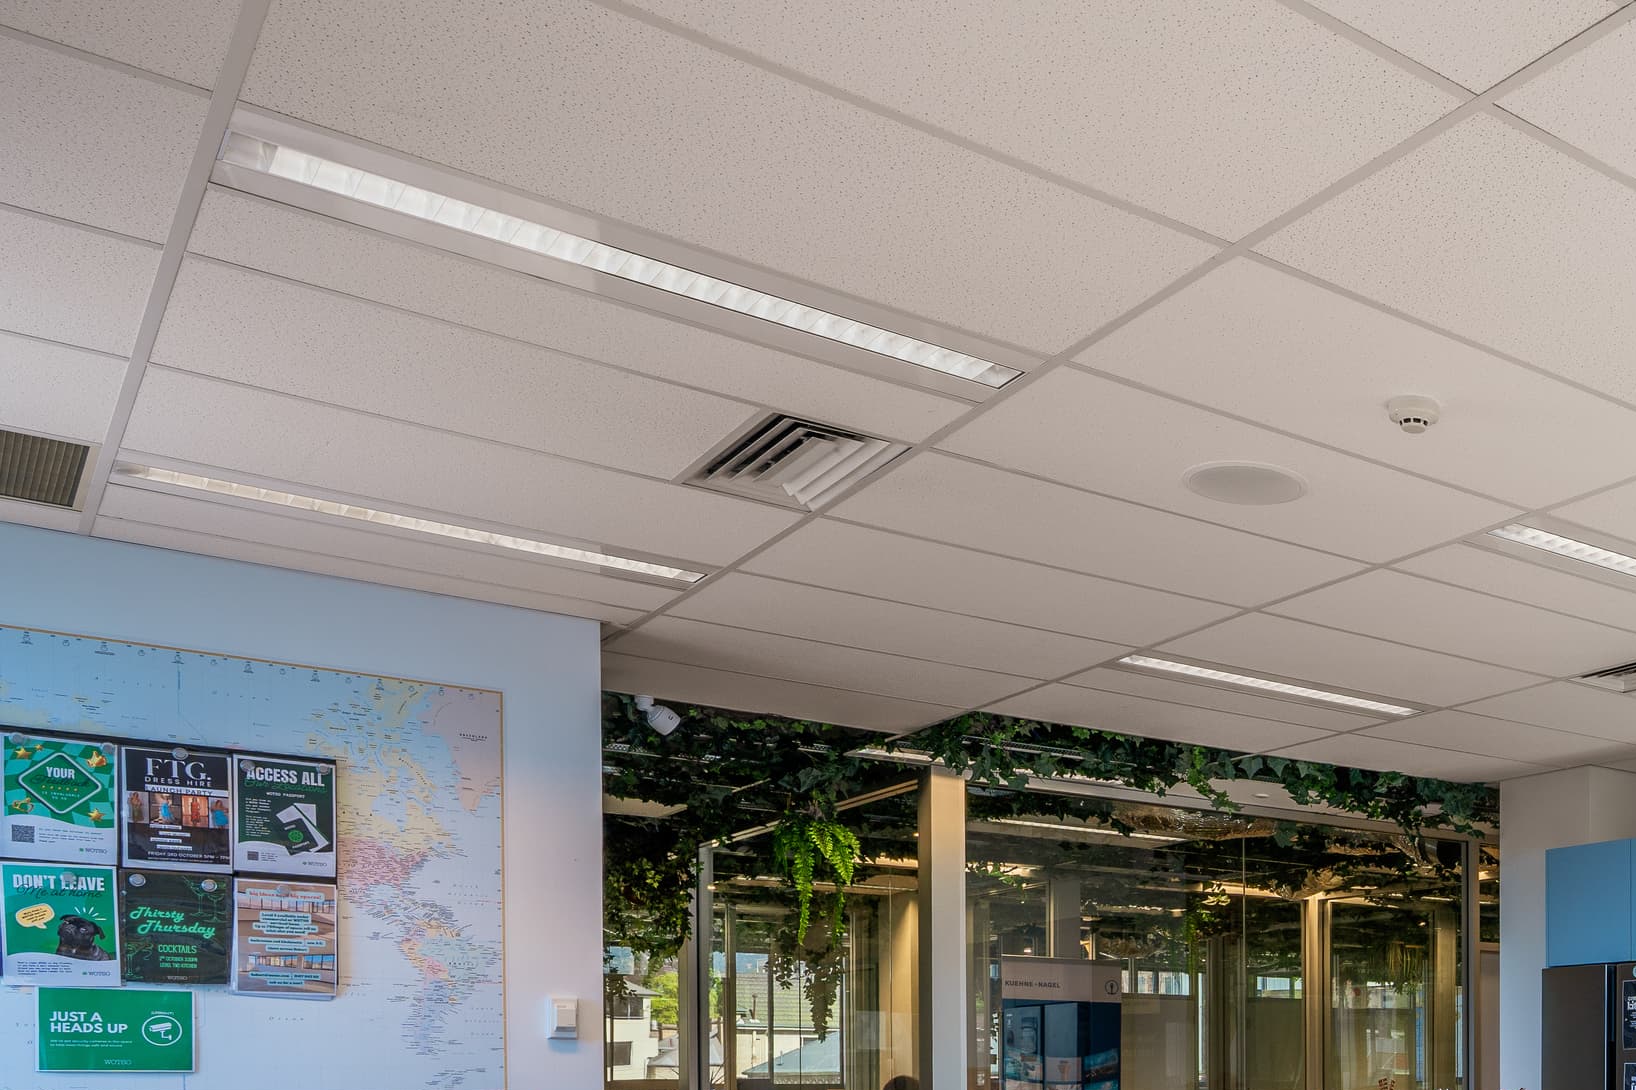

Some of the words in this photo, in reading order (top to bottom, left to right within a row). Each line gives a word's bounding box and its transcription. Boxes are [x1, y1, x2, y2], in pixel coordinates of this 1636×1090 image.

[46, 766, 75, 780] YOUR
[145, 757, 212, 781] FTG.
[144, 776, 180, 785] DRESS
[246, 767, 298, 784] ACCESS
[301, 771, 325, 787] ALL
[184, 789, 213, 797] PARTY
[12, 873, 57, 889] DON'T
[129, 906, 185, 923] Thirsty
[137, 919, 216, 939] Thursday
[158, 944, 197, 954] COCKTAILS
[49, 1011, 87, 1022] JUST
[90, 1012, 103, 1022] A
[50, 1022, 104, 1034] HEADS
[107, 1023, 129, 1034] UP
